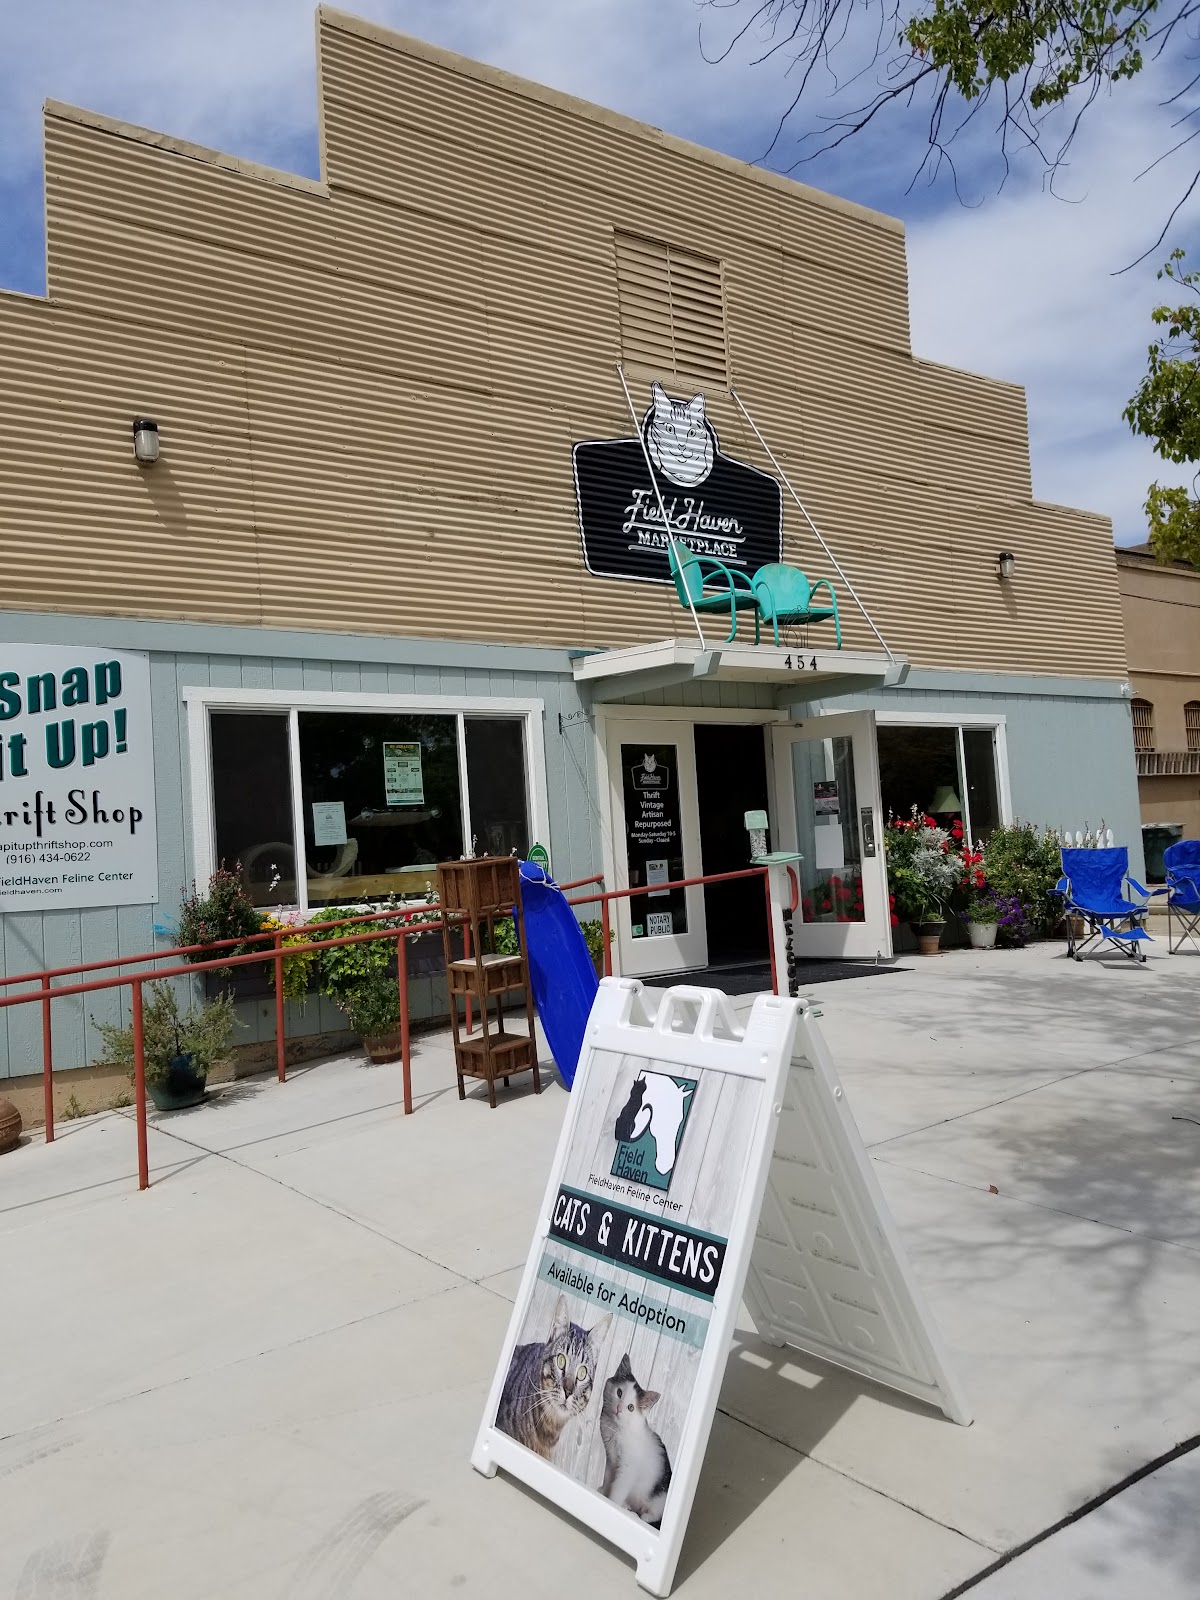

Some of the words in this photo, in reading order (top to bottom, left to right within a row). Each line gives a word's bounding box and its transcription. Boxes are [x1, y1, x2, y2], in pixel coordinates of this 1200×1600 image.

[622, 488, 678, 533] Field
[677, 498, 744, 534] Haven
[785, 654, 817, 671] 454
[0, 659, 122, 720] Snap
[0, 732, 28, 781] t
[45, 707, 128, 768] Up!
[640, 801, 664, 810] Vintage
[643, 791, 660, 799] Thrift
[0, 789, 56, 838] rift
[65, 789, 143, 835] Shop
[634, 819, 672, 829] Repurposed
[6, 853, 36, 864] (916)
[39, 851, 91, 863] 434-0622
[0, 875, 59, 887] ieldHaven
[62, 873, 95, 883] Feline
[98, 872, 134, 882] Center
[649, 914, 670, 925] NOTARY
[650, 925, 671, 935] PUBLIC
[618, 1144, 645, 1167] Field
[615, 1161, 648, 1184] Haven
[588, 1174, 625, 1193] FieldHaven
[626, 1185, 651, 1202] Feline
[652, 1194, 684, 1212] Center
[553, 1194, 590, 1237] CATS
[597, 1211, 613, 1247] &
[621, 1220, 718, 1283] KITTENS
[547, 1262, 594, 1296] Available
[598, 1281, 616, 1304] for
[618, 1293, 686, 1334] Adoption
